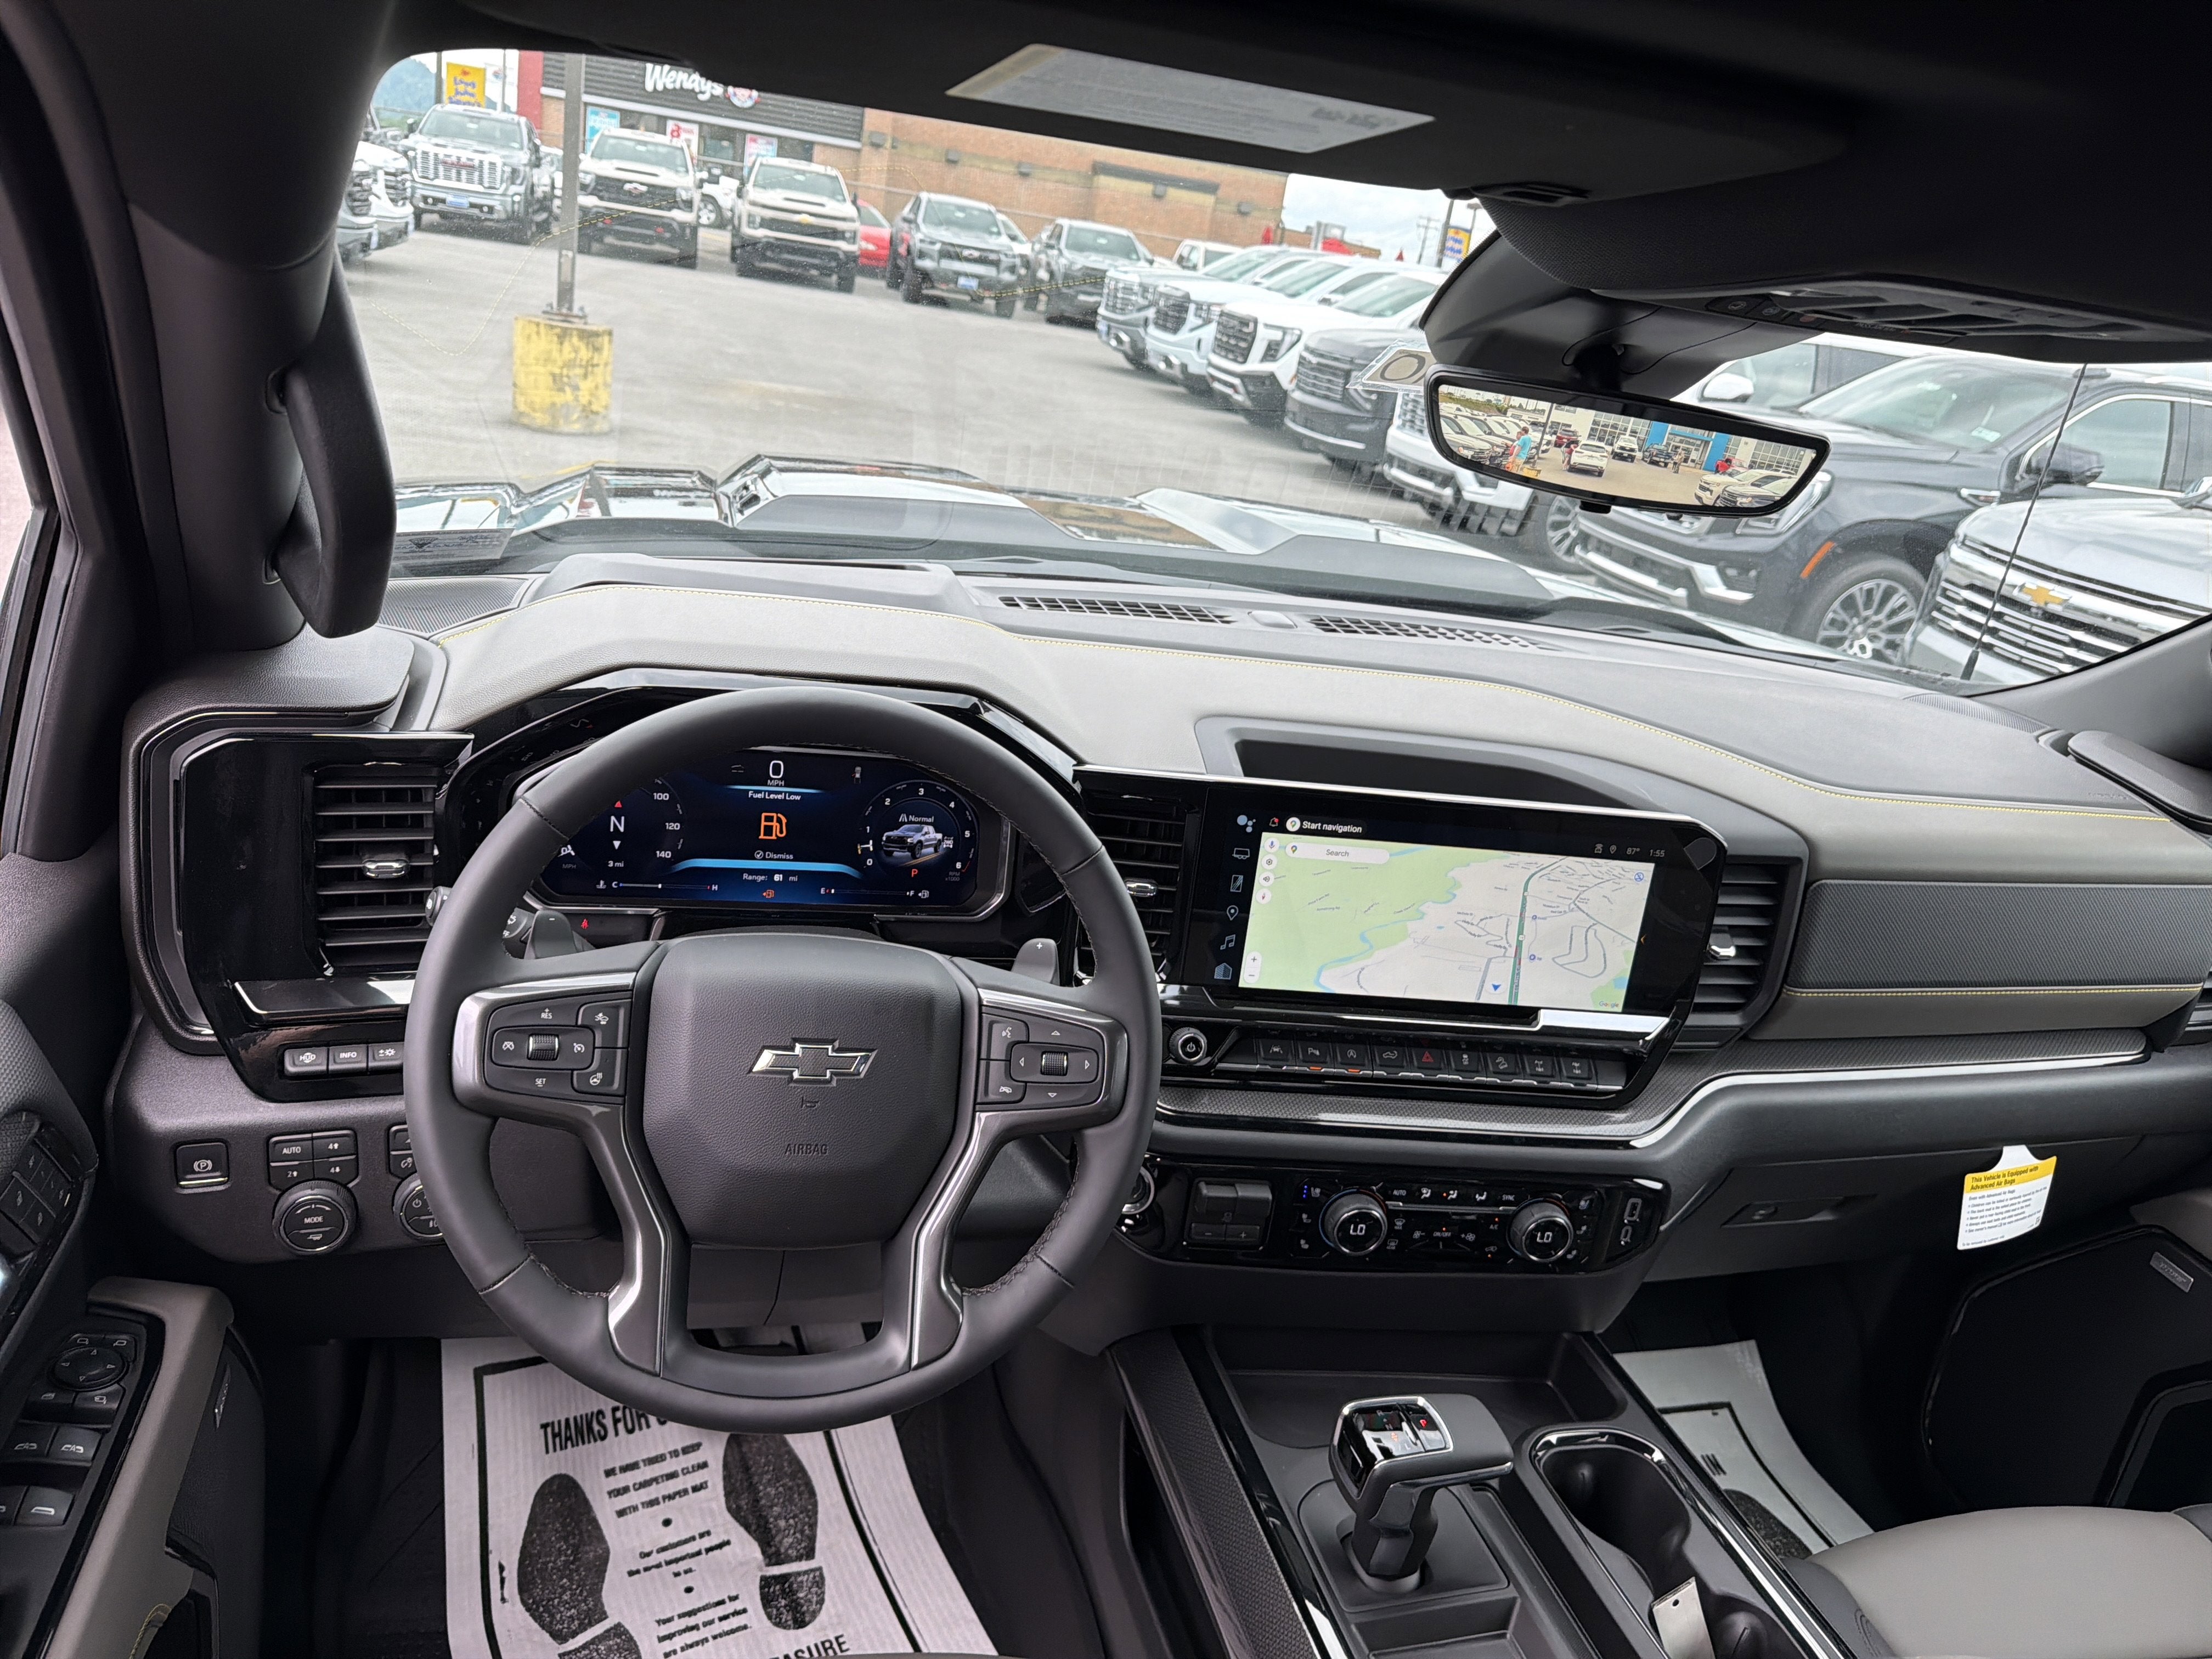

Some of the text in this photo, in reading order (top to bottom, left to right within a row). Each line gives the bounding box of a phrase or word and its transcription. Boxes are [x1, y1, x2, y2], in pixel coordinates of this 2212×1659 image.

[645, 63, 724, 101] Wendys
[769, 760, 784, 778] 0
[748, 791, 764, 799] Fuel
[610, 815, 625, 832] N
[1302, 821, 1362, 834] Start navigation
[1325, 849, 1349, 857] Search
[743, 873, 768, 882] Range:
[911, 869, 918, 877] P
[299, 1053, 316, 1063] HUD
[340, 1051, 357, 1059] INFO
[282, 1146, 301, 1155] AUTO
[784, 1143, 829, 1155] AIRBAG
[2007, 1168, 2028, 1177] Equipped
[1970, 1182, 1995, 1190] Advanced
[304, 1215, 324, 1224] MODE
[1350, 1224, 1366, 1235] LO
[1536, 1232, 1553, 1243] LO
[540, 1405, 651, 1454] THANKS FOR
[603, 1441, 703, 1479] WE HAVE TRIED TO KEEP
[606, 1460, 709, 1499] YOUR CARPETING CLEAN
[614, 1480, 709, 1519] WITH THIS PAPER MAT
[639, 1529, 712, 1559] Our customers are
[627, 1538, 731, 1577] the most important people
[654, 1593, 740, 1627] Your suggestions for
[657, 1607, 748, 1644] improving our service
[663, 1623, 753, 1659] are always welcome.
